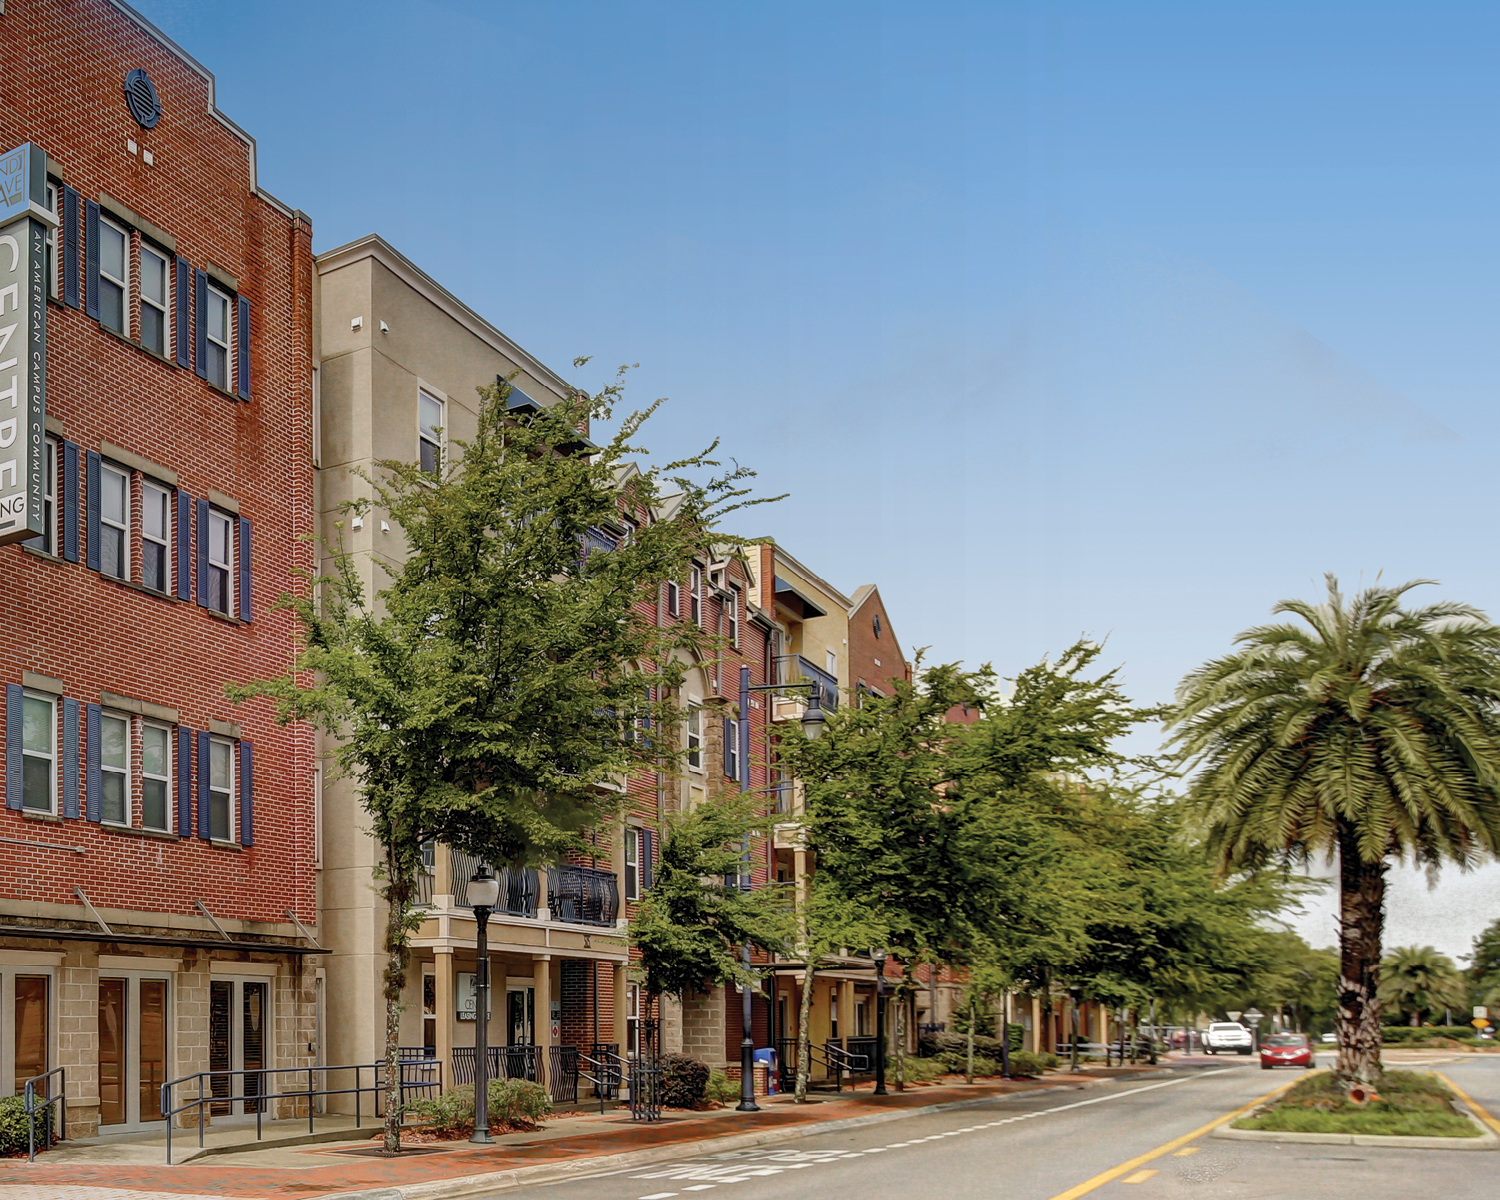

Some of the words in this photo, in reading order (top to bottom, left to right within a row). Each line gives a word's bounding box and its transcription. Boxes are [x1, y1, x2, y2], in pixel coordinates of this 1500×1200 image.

[34, 231, 42, 254] AN
[33, 260, 42, 343] AMERICAN
[33, 351, 41, 414] CAMPUS
[32, 422, 41, 521] COMMUNITY
